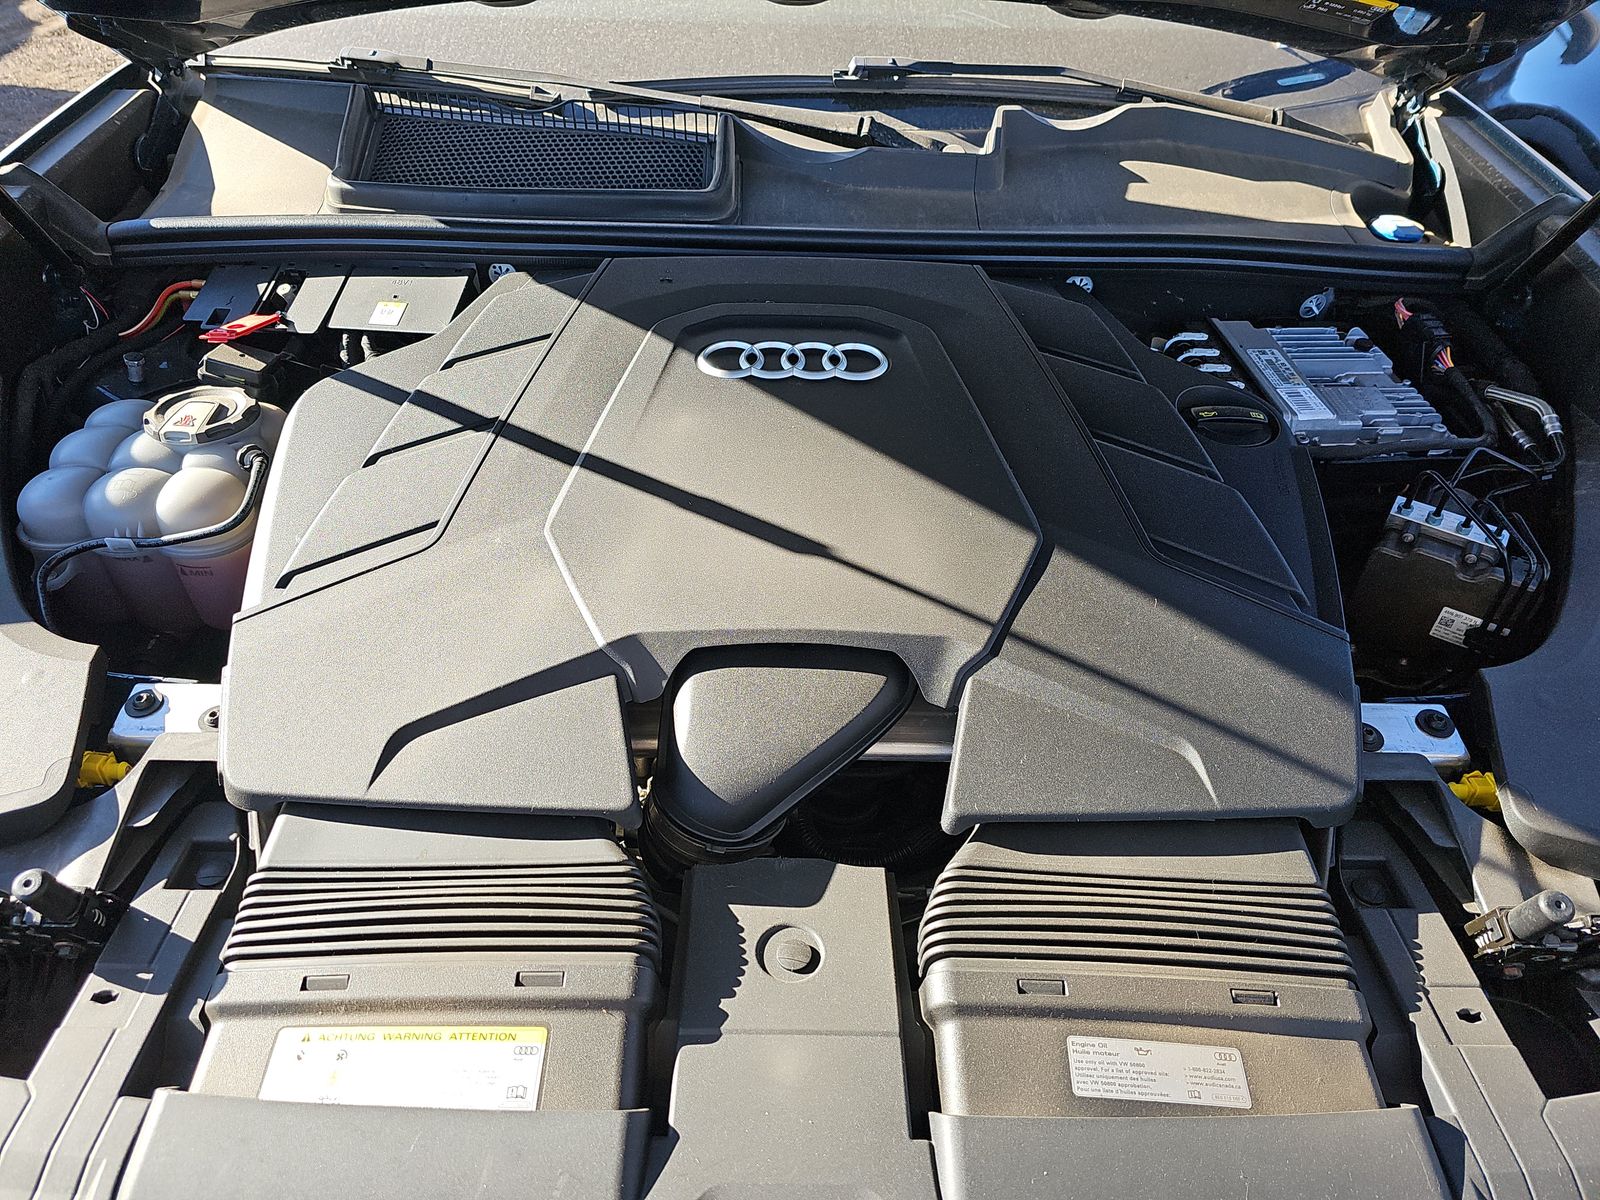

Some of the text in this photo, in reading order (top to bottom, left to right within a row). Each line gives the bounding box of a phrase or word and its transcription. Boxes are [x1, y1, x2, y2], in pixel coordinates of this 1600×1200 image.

[190, 569, 214, 577] MIN
[319, 1032, 517, 1041] ACHTUNG WARNING ATTENTION
[1071, 1041, 1096, 1049] Engine
